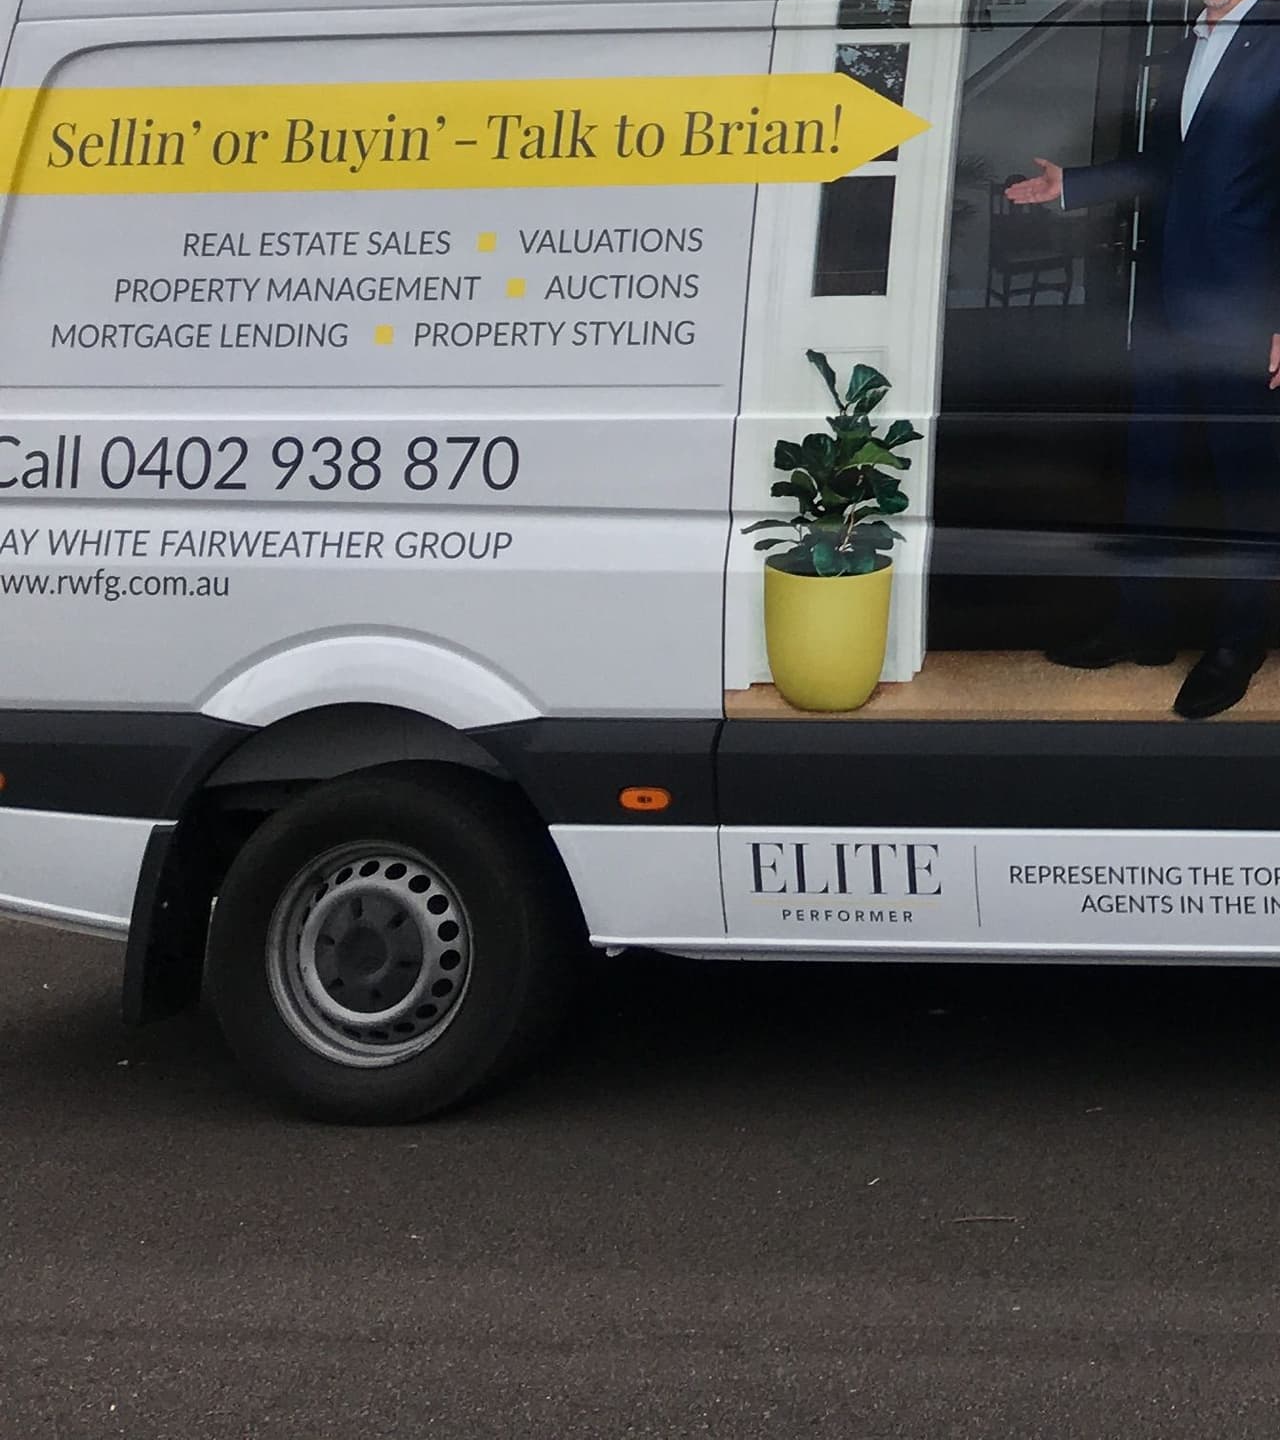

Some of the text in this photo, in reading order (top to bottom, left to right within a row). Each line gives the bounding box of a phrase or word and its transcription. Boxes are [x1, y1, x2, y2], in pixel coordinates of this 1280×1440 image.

[47, 117, 202, 169] Sellin’
[212, 128, 269, 166] or
[281, 113, 446, 174] Buyin’
[614, 114, 665, 159] to
[680, 104, 843, 157] Brian!
[183, 227, 704, 257] REAL ESTATE SALES VALUATIONS
[114, 273, 700, 303] PROPERTY MANAGEMENT AUCTIONS
[50, 320, 696, 349] MORTGAGE LENDING PROPERTY STYLING
[100, 435, 249, 491] 0402
[271, 435, 382, 491] 938
[403, 435, 520, 491] 870
[0, 528, 513, 560] AY WHITE FAIRWEATHER GROUP
[0, 567, 230, 602] ww.rwfg.com.au
[746, 842, 942, 897] ELITE
[1009, 864, 1183, 886] REPRESENTING
[1187, 866, 1235, 887] THE
[781, 908, 914, 924] PERFORMER
[1080, 893, 1174, 915] AGENTS
[1180, 895, 1204, 915] IN
[1209, 895, 1257, 915] THE
